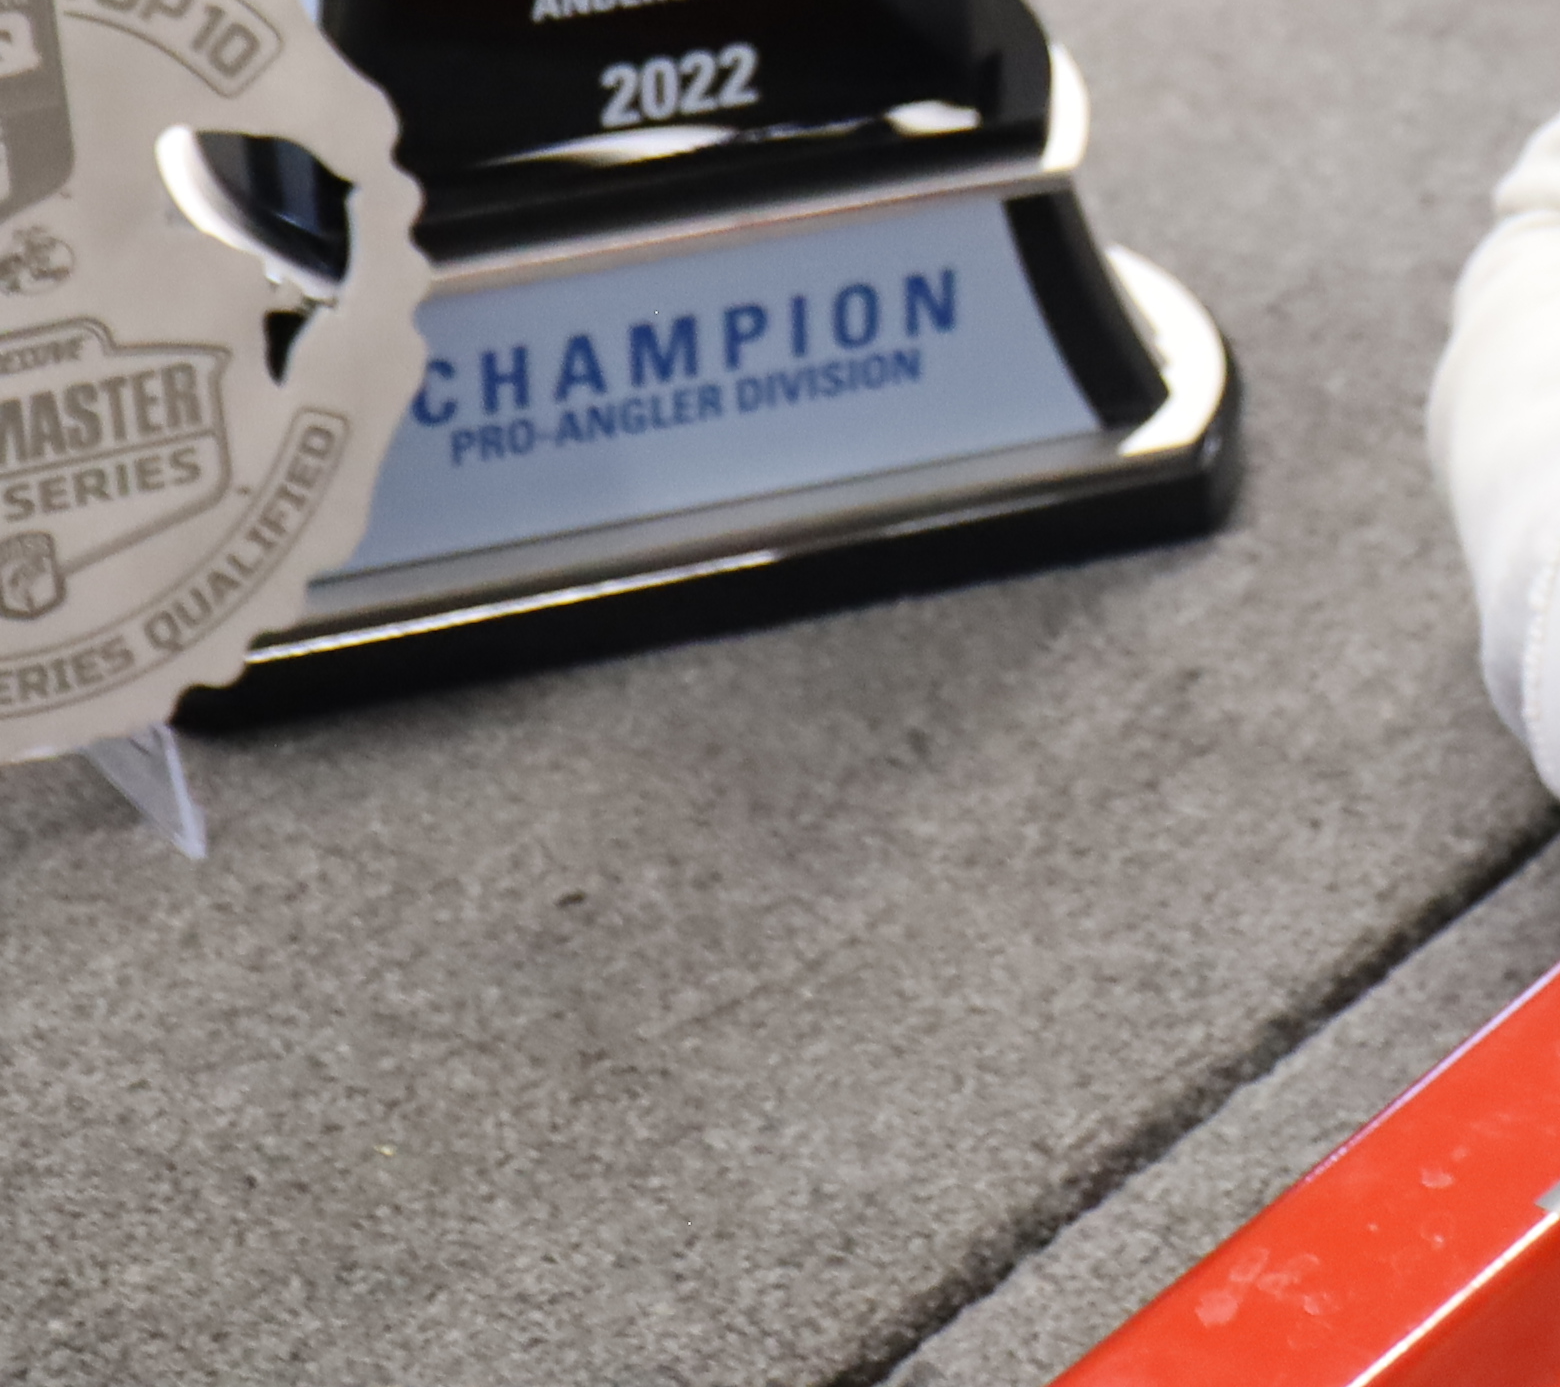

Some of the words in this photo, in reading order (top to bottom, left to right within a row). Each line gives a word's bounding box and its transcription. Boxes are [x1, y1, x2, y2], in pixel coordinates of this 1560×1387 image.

[600, 42, 760, 128] 2022
[413, 268, 956, 428] CHAMPION
[451, 383, 723, 467] PRO-ANGLER
[736, 348, 921, 414] DIVISION
[1, 446, 202, 524] SERIES
[146, 422, 337, 654] QUALIFIED
